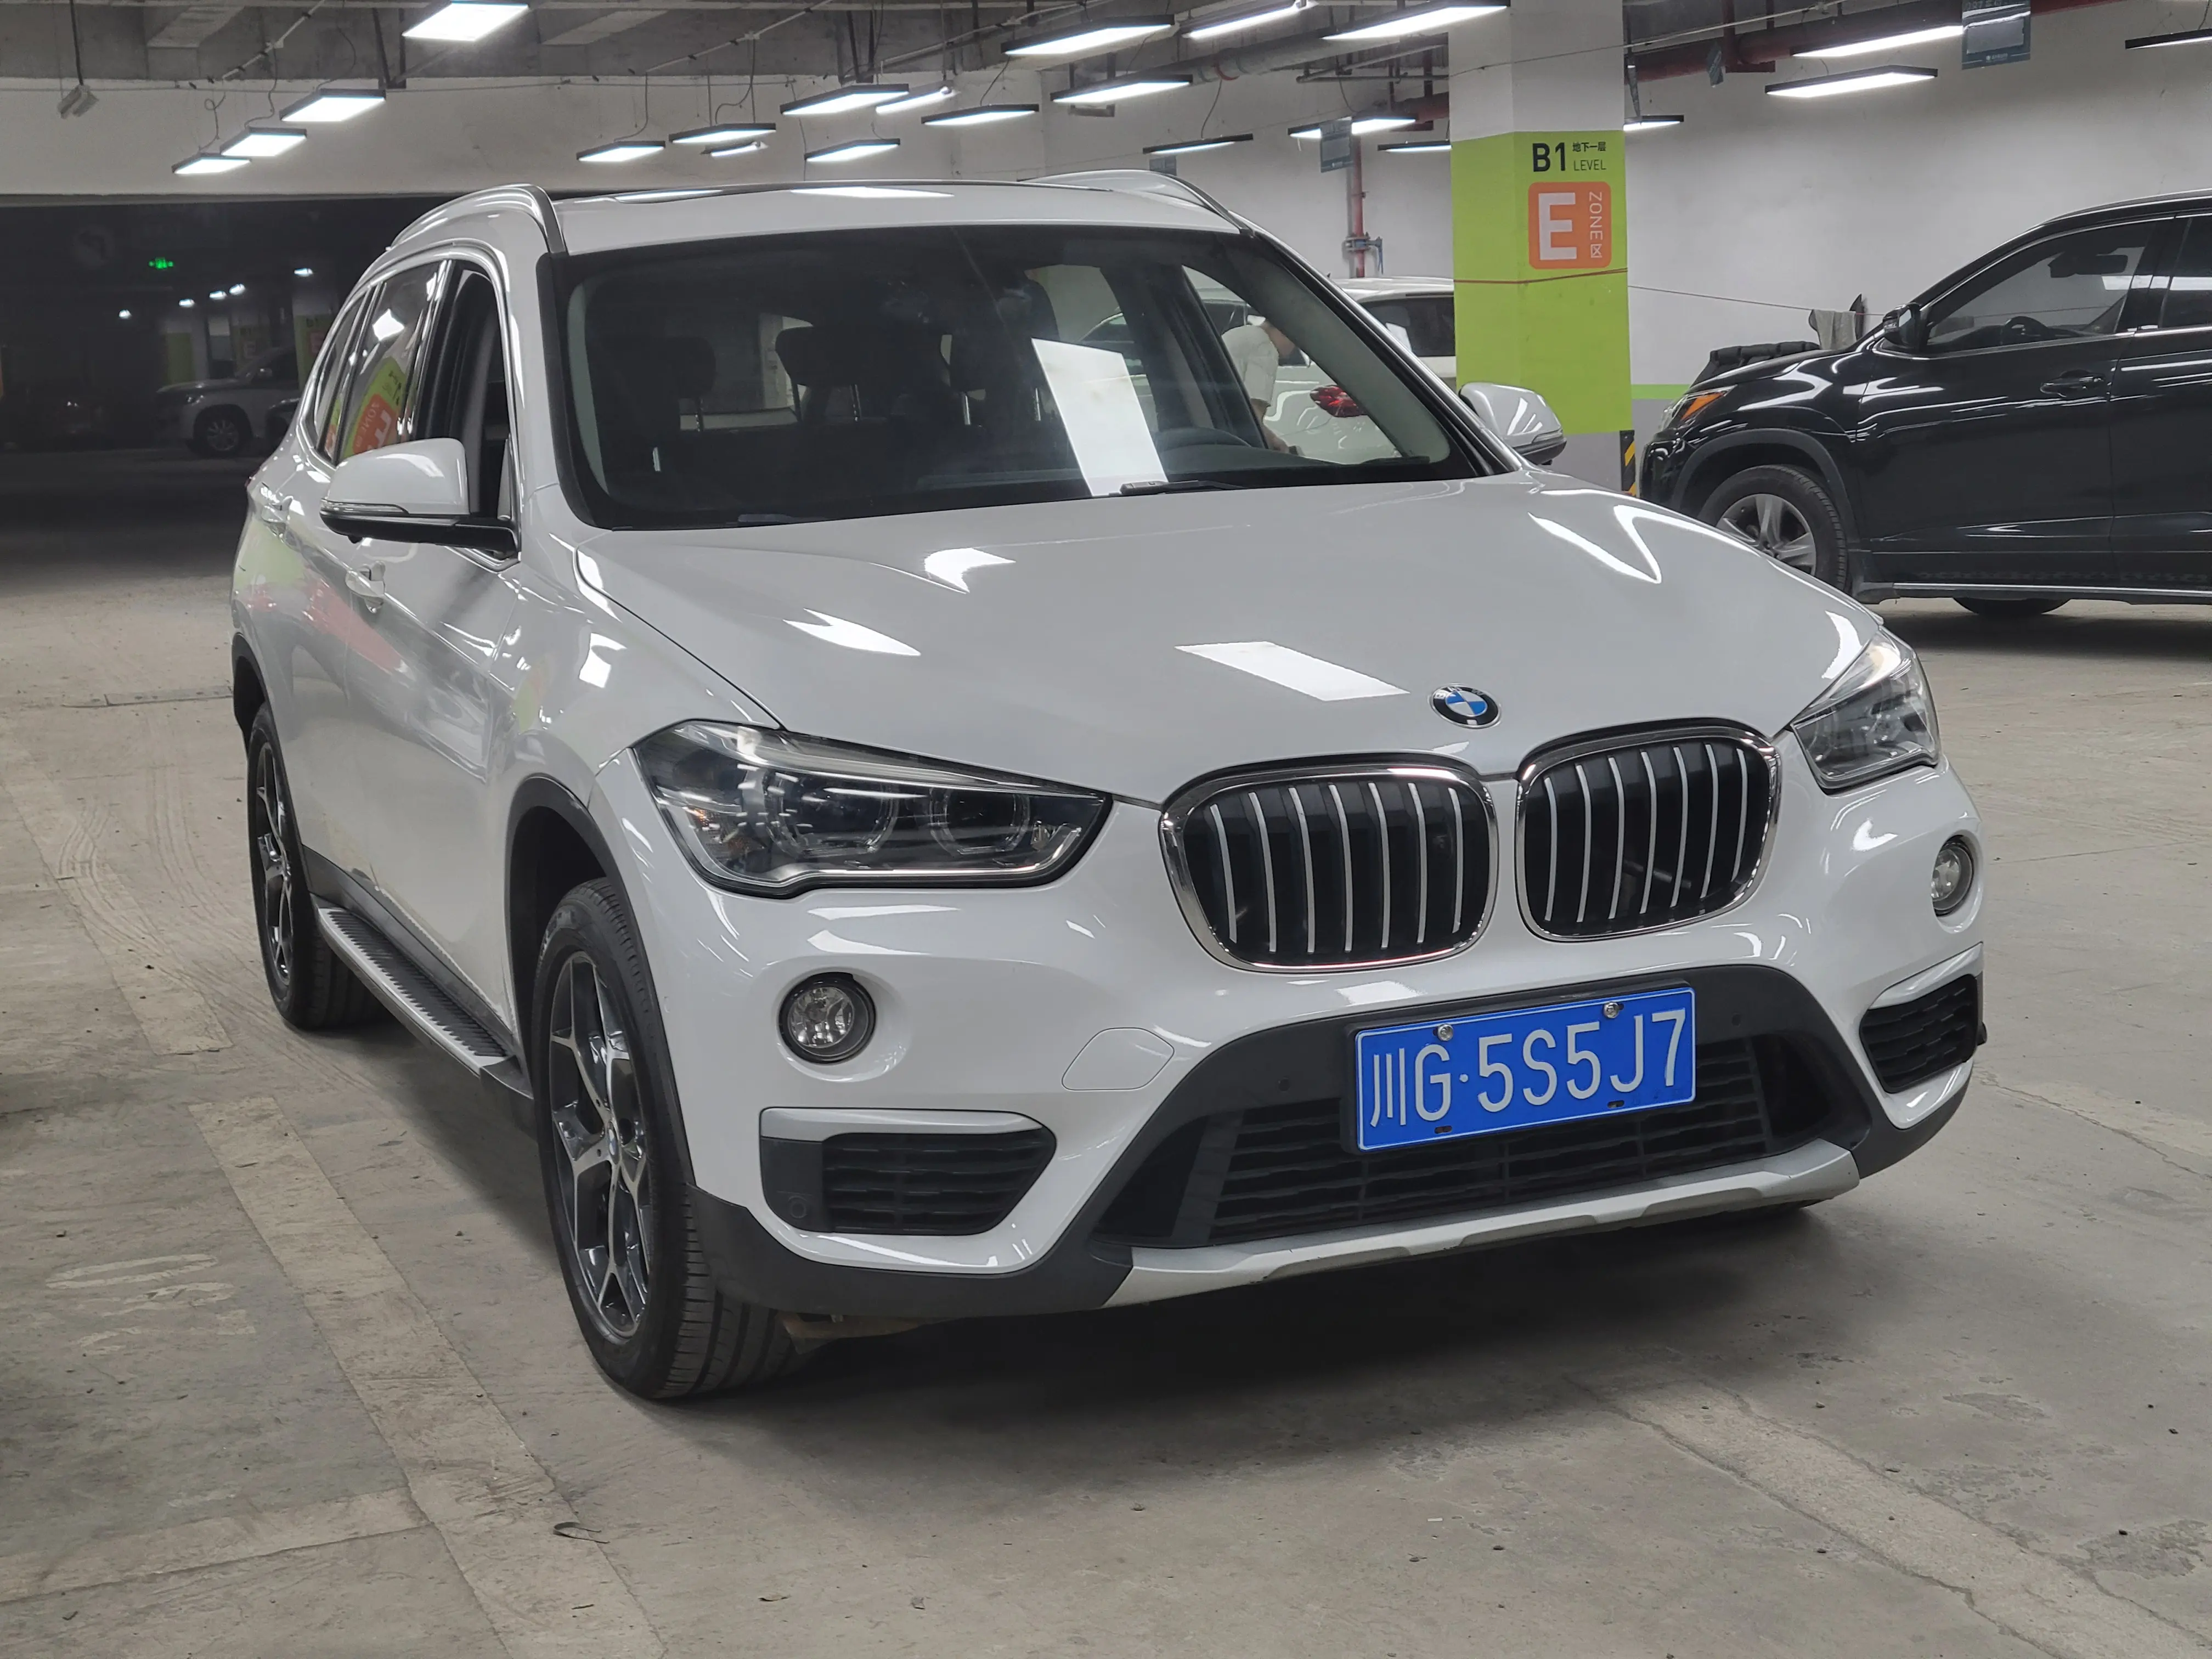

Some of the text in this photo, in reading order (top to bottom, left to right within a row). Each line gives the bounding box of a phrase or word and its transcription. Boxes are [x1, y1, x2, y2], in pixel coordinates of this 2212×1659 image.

[1532, 142, 1566, 172] B1
[1572, 141, 1606, 153] 地下一层
[1573, 159, 1607, 171] LEVEL
[1538, 192, 1577, 260] E
